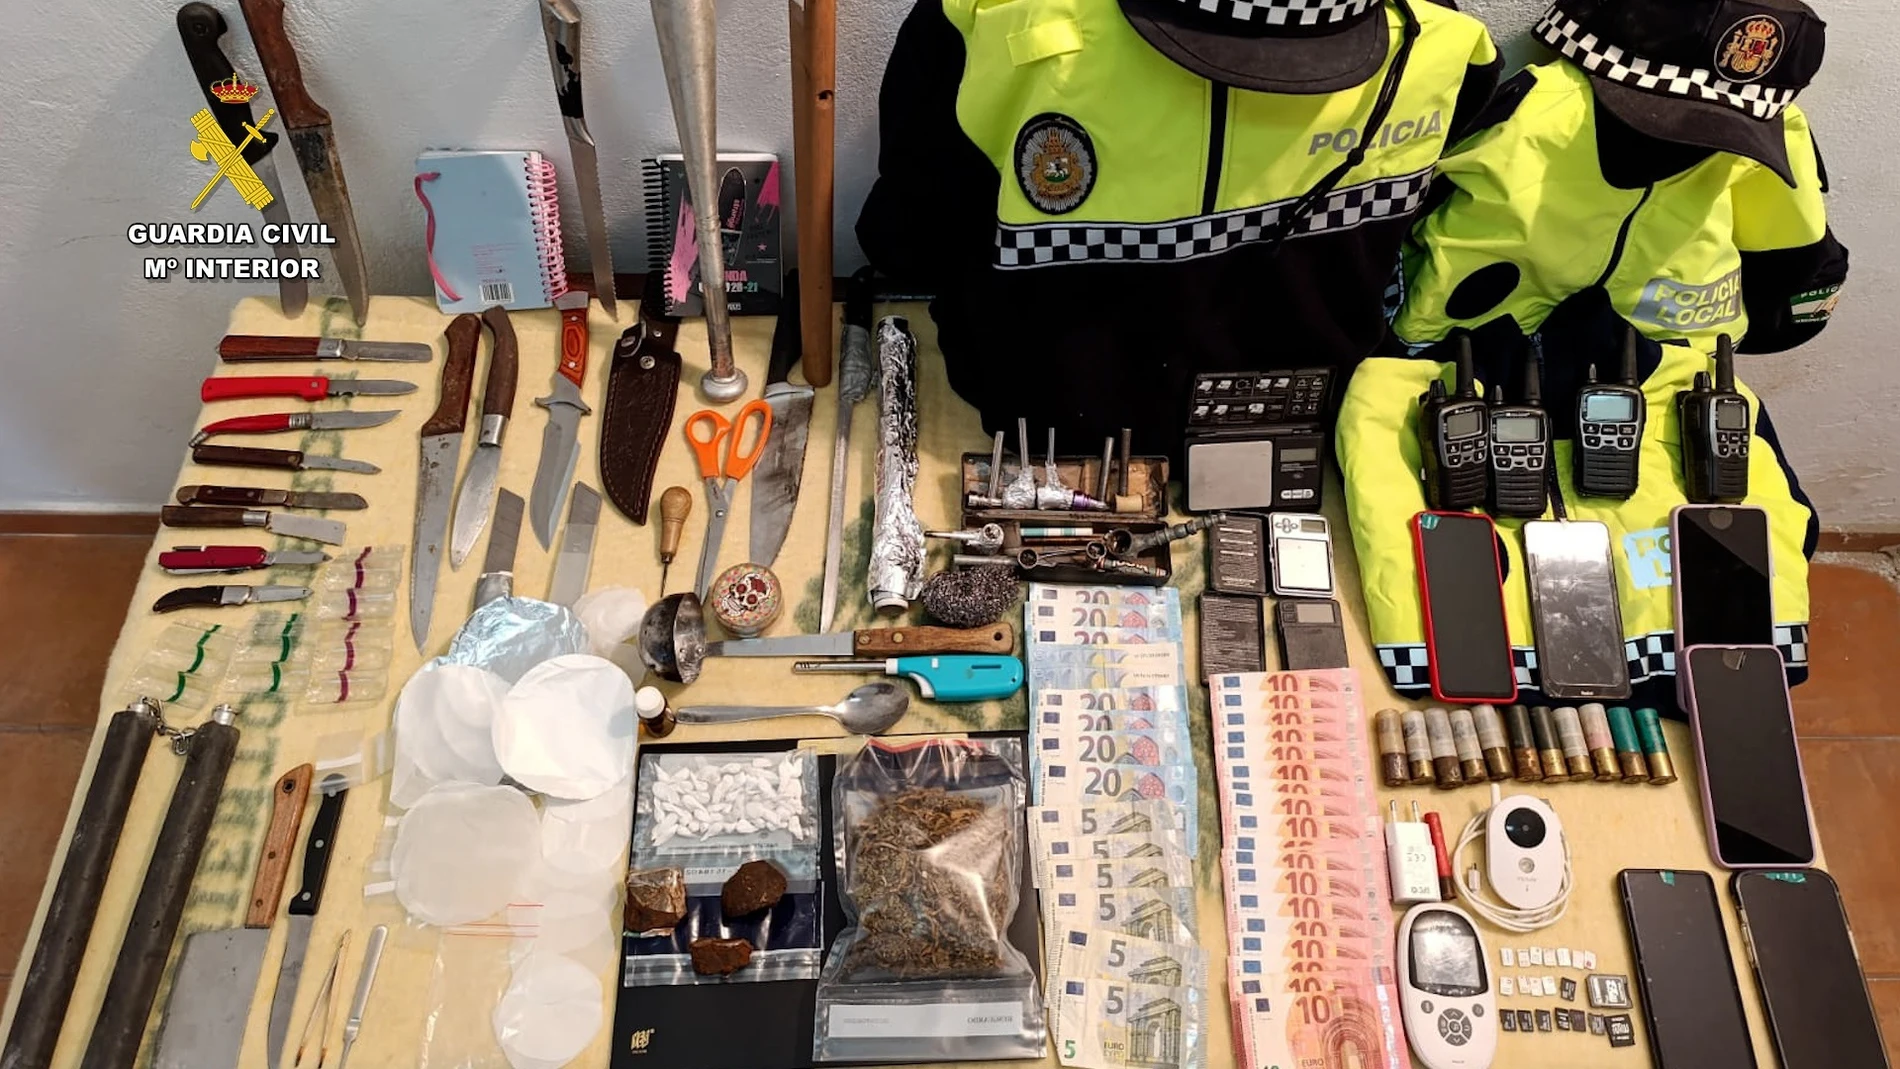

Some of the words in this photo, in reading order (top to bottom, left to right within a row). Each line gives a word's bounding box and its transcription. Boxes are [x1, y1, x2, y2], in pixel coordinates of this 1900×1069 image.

[1308, 110, 1442, 156] POICIA
[725, 270, 748, 282] NDA
[1655, 299, 1736, 326] LOCAL
[1075, 590, 1110, 605] 20
[1072, 607, 1107, 627] 20
[1267, 674, 1299, 692] 10
[1080, 692, 1116, 710] 20
[1268, 695, 1300, 709] 10
[1078, 714, 1112, 731] 20
[1271, 711, 1302, 725] 10
[1271, 729, 1303, 743] 10
[1078, 735, 1116, 763] 20
[1271, 746, 1303, 760] 10
[1084, 766, 1122, 797] 20
[1276, 764, 1308, 781] 10
[1280, 798, 1312, 815] 10
[1081, 808, 1098, 835] 5
[1285, 817, 1318, 838] 10
[1093, 840, 1109, 859] 5
[1282, 853, 1315, 869] 10
[1097, 863, 1114, 888] 5
[1285, 872, 1318, 896] 10
[1099, 894, 1116, 921] 5
[1287, 897, 1320, 919] 10
[1294, 921, 1327, 937] 10
[1107, 939, 1128, 968] 5
[1291, 939, 1324, 958] 10
[1289, 977, 1322, 992] 10
[1106, 985, 1124, 1015] 5
[1295, 995, 1330, 1025] 10
[1064, 1039, 1076, 1059] 5
[1103, 1041, 1125, 1050] EURO
[1301, 1058, 1325, 1067] EURO
